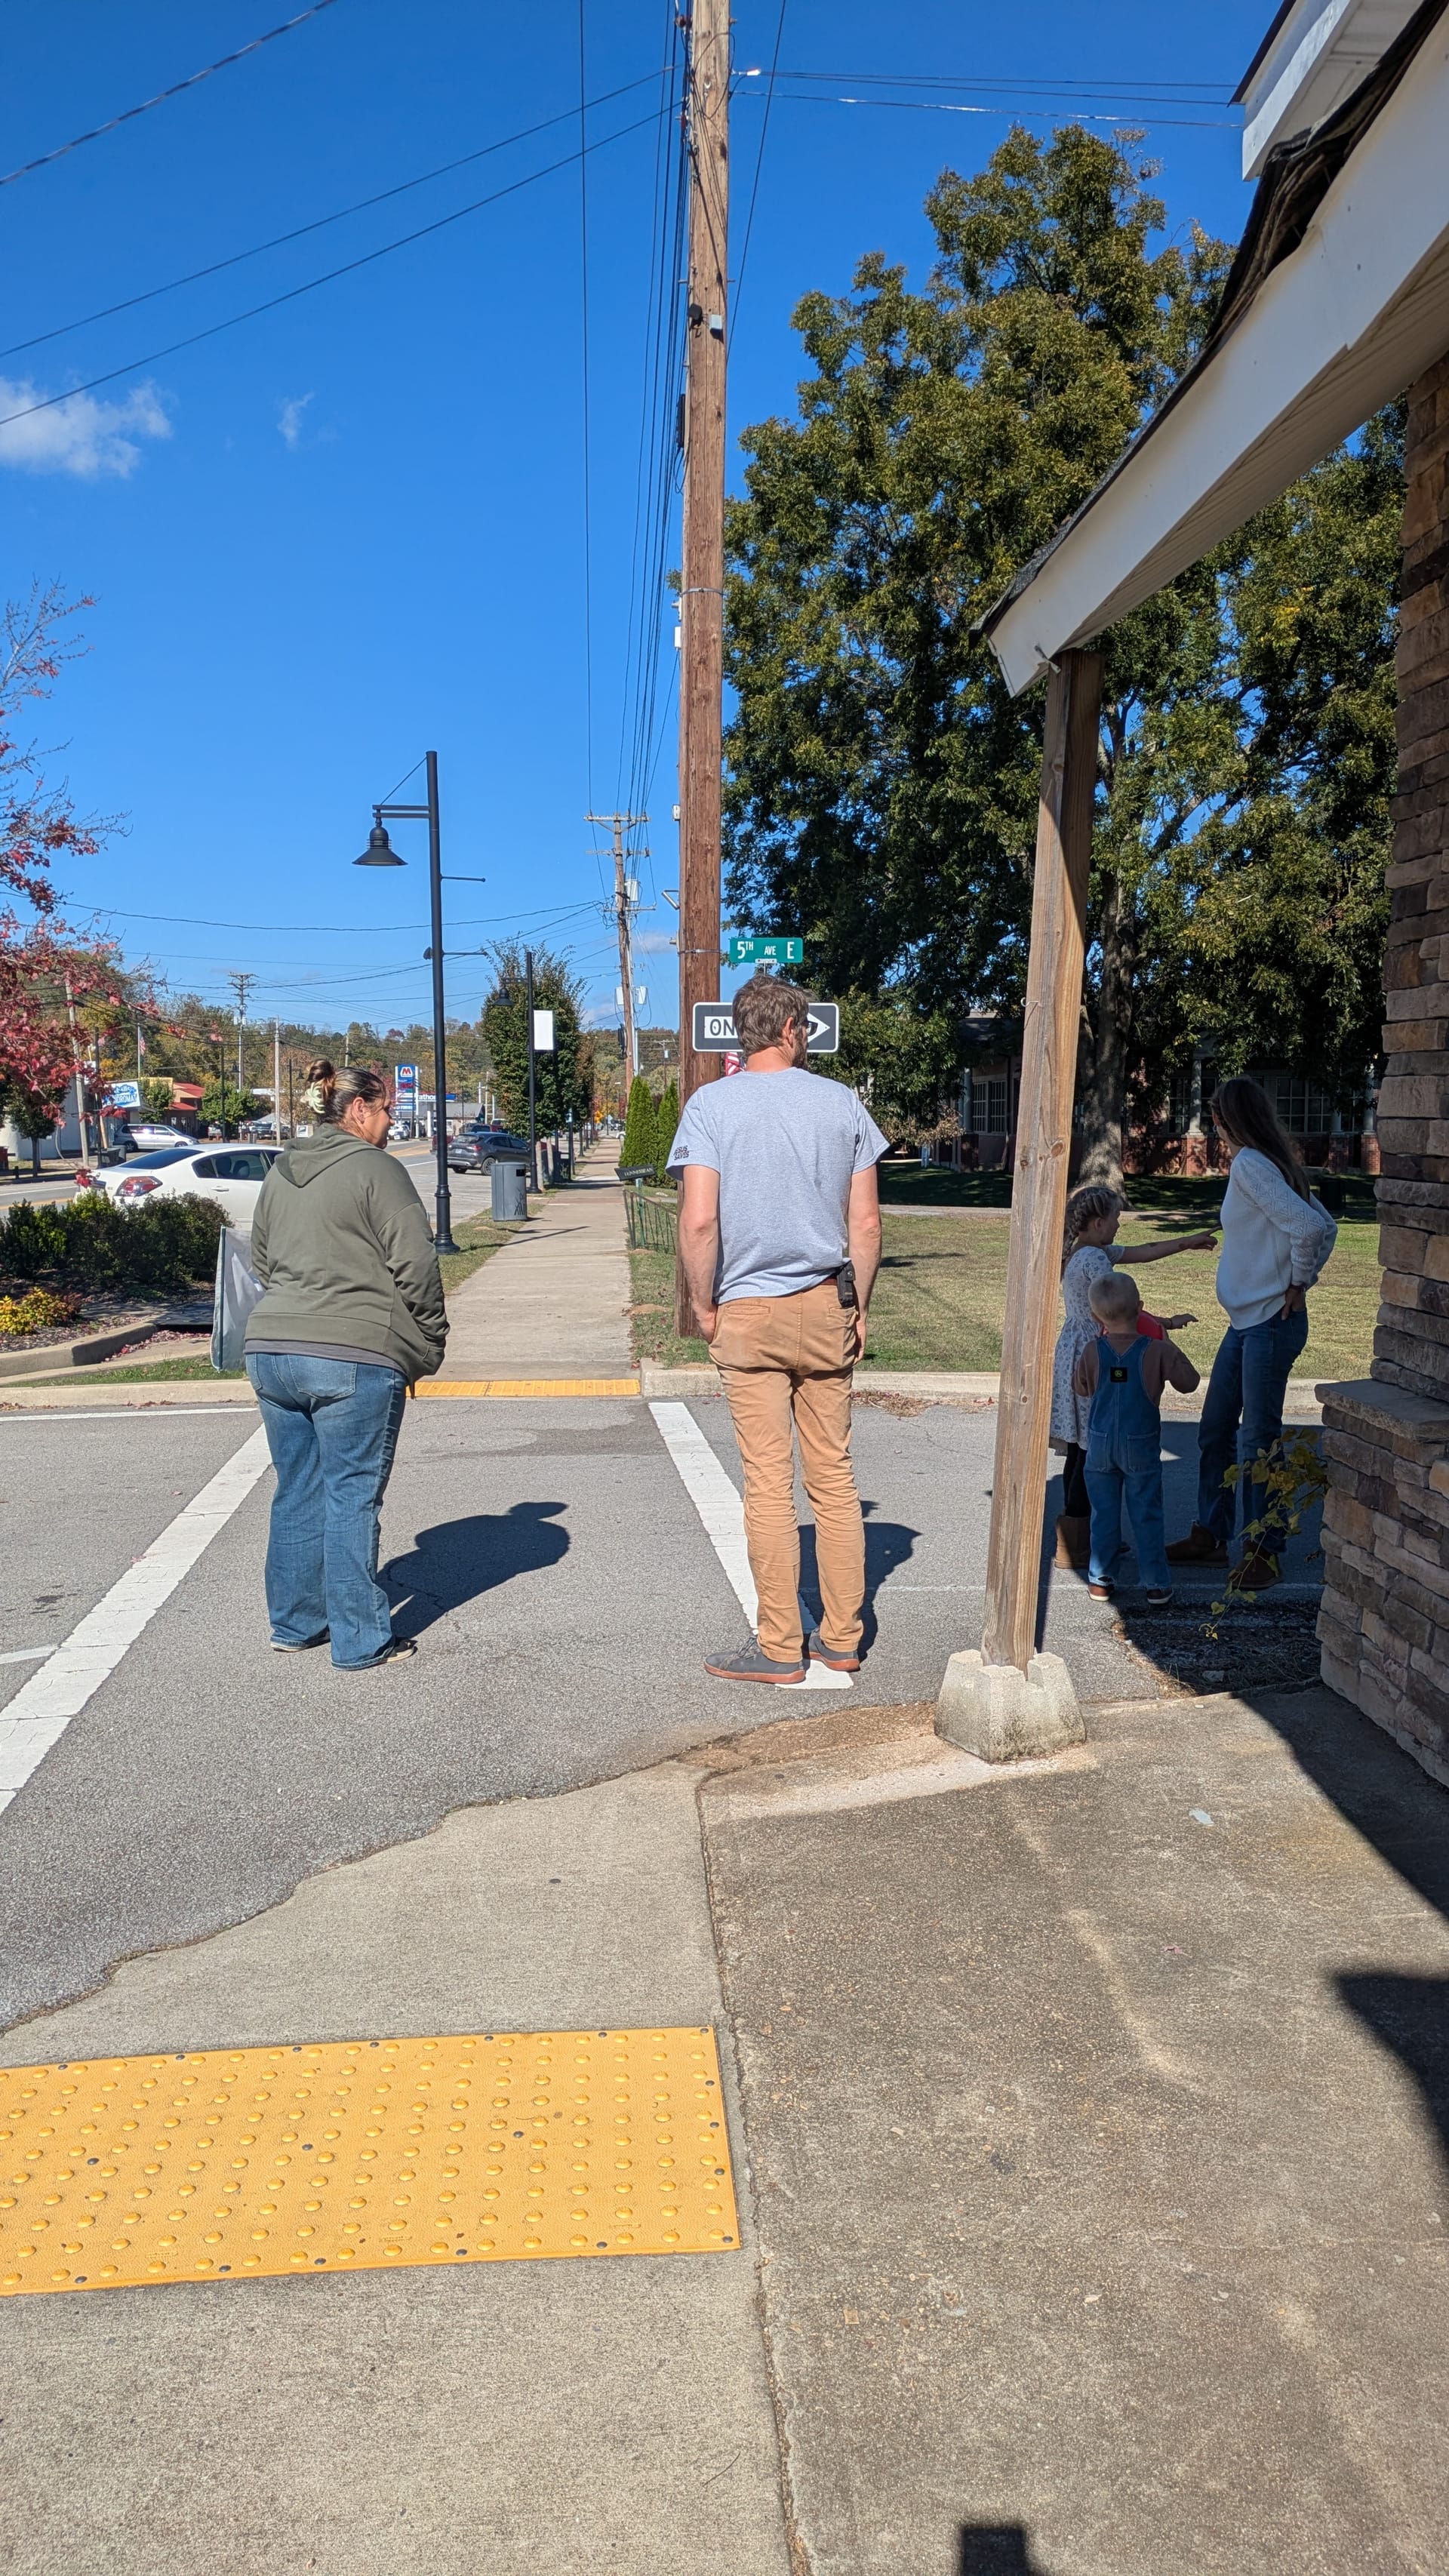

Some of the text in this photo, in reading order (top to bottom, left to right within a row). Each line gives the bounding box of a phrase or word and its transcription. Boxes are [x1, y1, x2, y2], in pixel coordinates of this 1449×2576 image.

[737, 941, 795, 959] 5TH AVE E
[709, 1018, 735, 1036] ON
